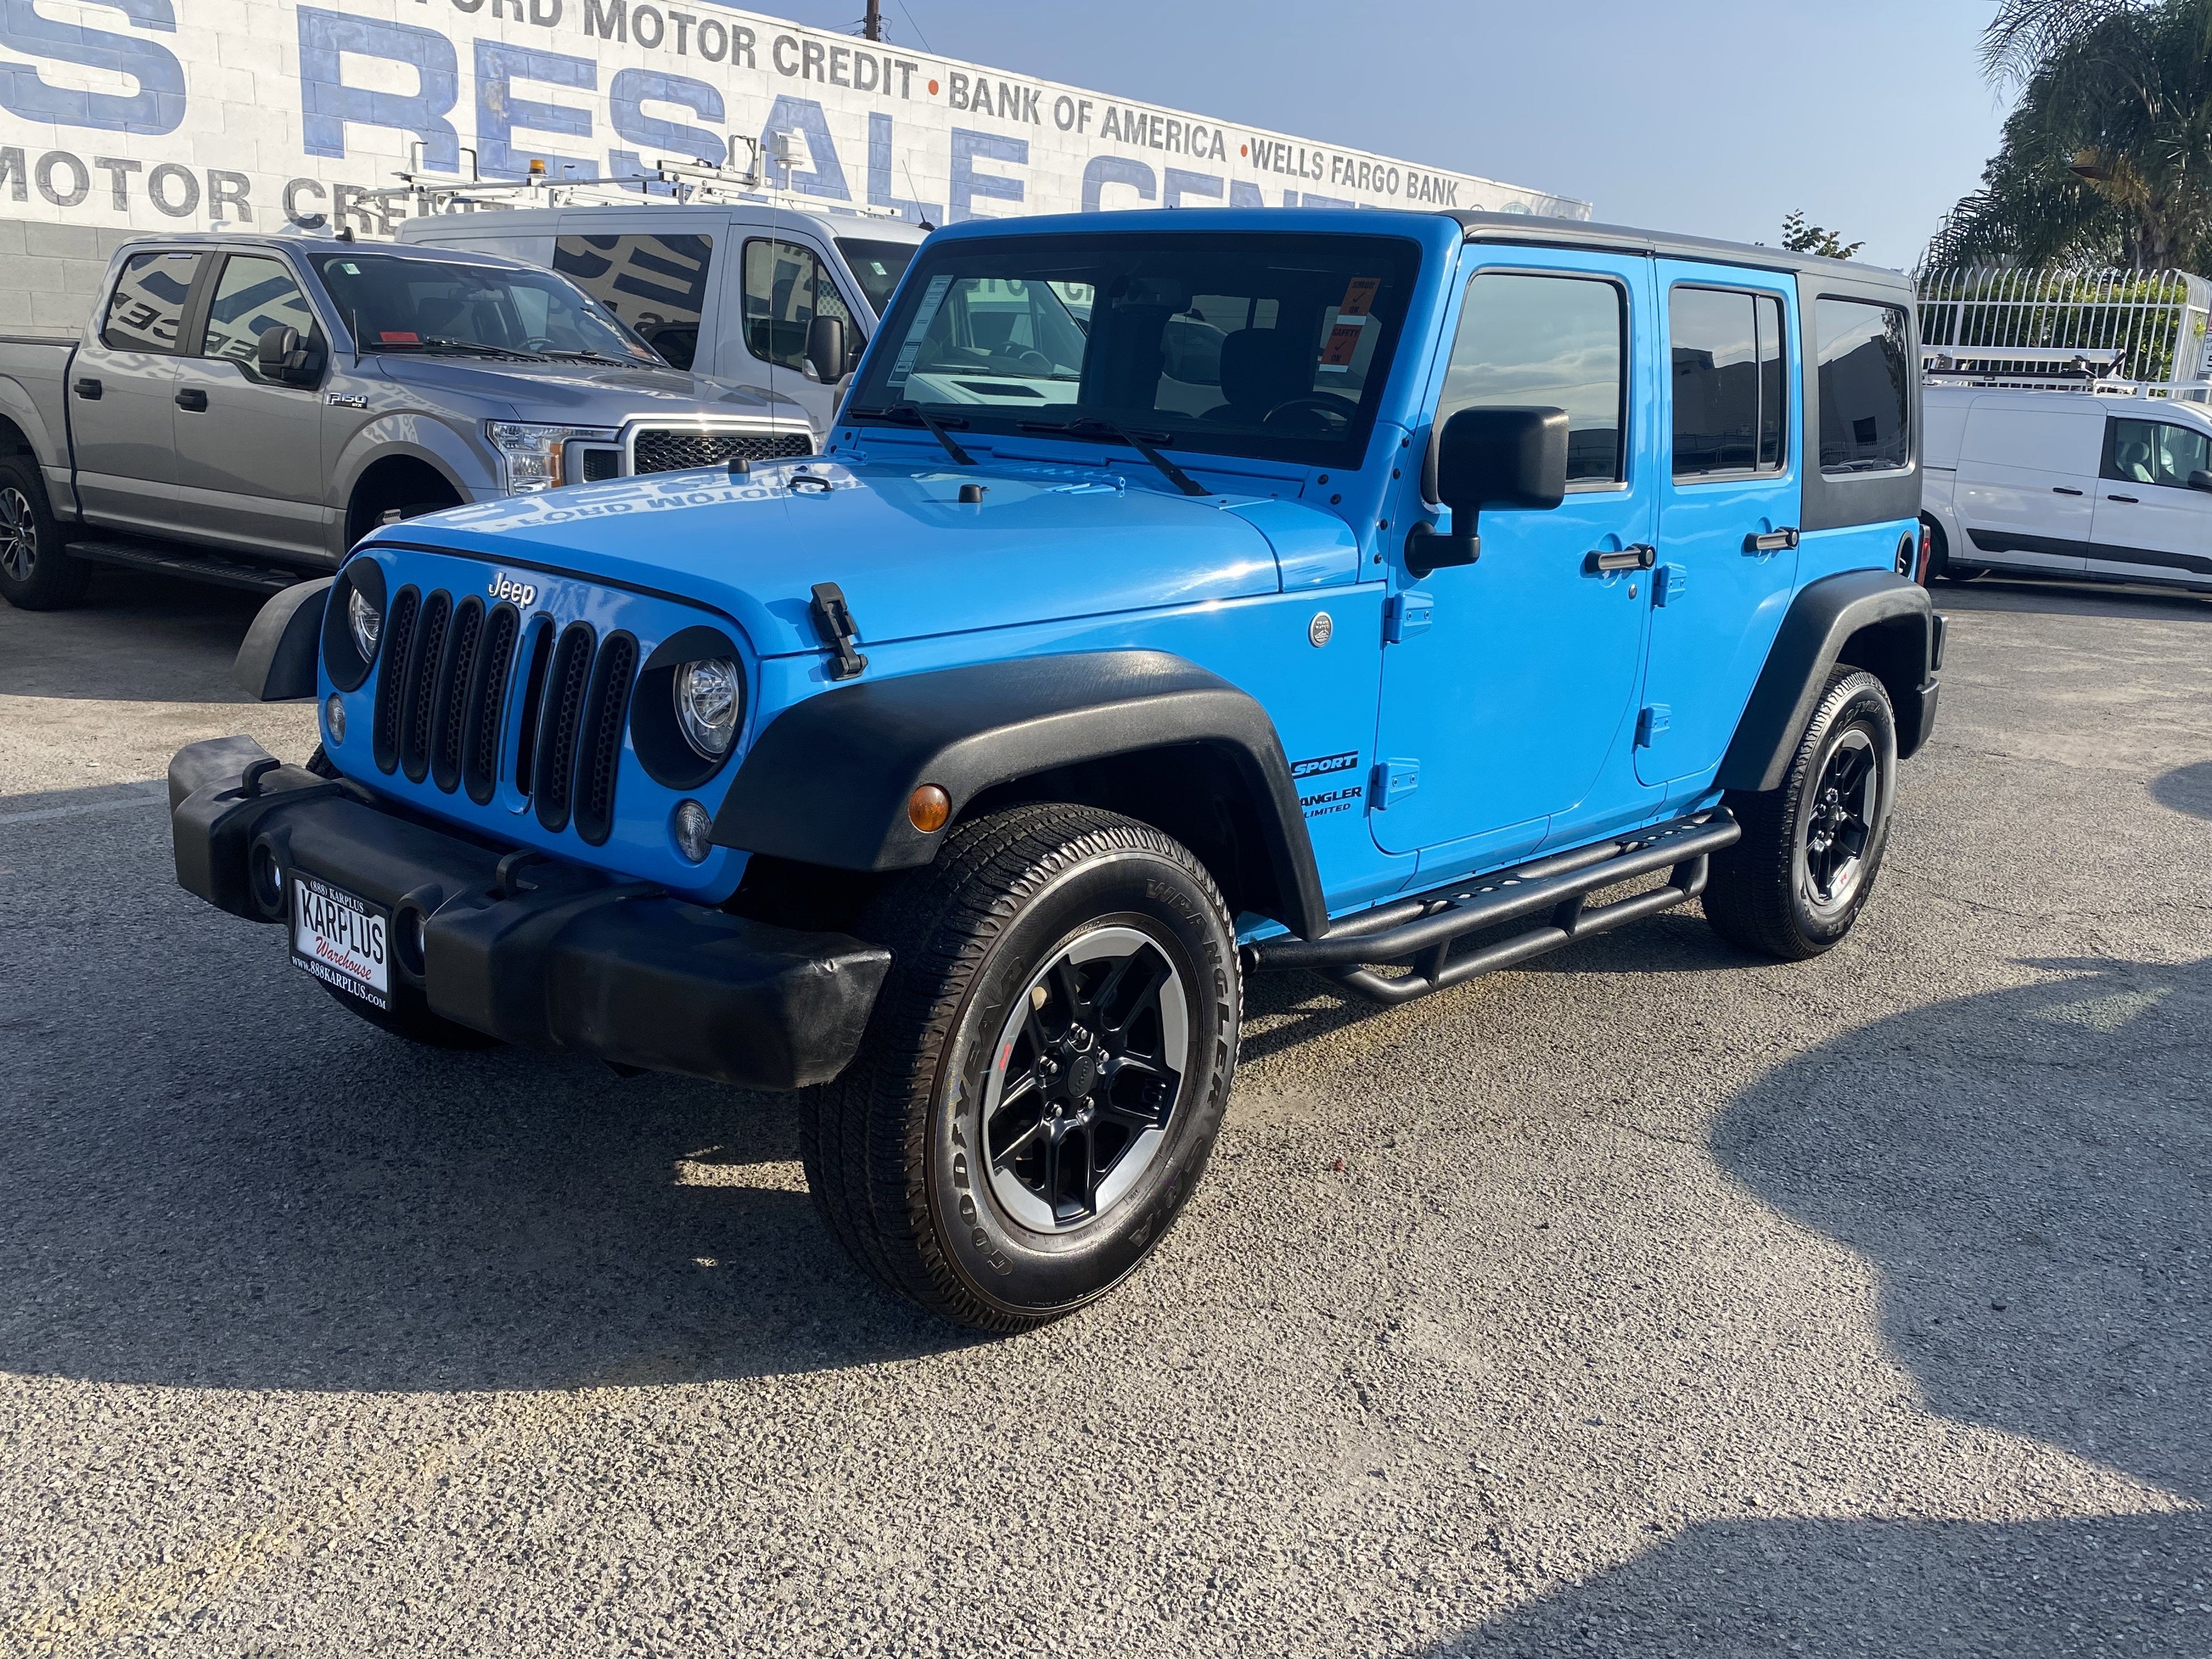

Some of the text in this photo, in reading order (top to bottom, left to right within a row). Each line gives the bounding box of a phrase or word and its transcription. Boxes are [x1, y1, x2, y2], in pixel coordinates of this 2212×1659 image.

[584, 0, 757, 69] MOTOR
[772, 34, 918, 100] CREDIT
[297, 4, 1029, 226] RESALE
[950, 71, 1226, 162] BANK OF AMERICA
[1251, 138, 1324, 180] WELLS
[1331, 156, 1400, 195] FARGO
[1406, 172, 1459, 207] BANK
[488, 572, 538, 610] Jeep
[1291, 755, 1358, 776] SPORT
[1299, 786, 1362, 807] ANGLER
[1304, 803, 1351, 819] LIMITED
[301, 888, 384, 965] KARPLUS
[310, 880, 364, 913] (888) KARPLUS
[315, 936, 372, 981] Warehouse
[1146, 878, 1229, 1108] WRANGLER
[951, 956, 1023, 1276] GOODYEAR
